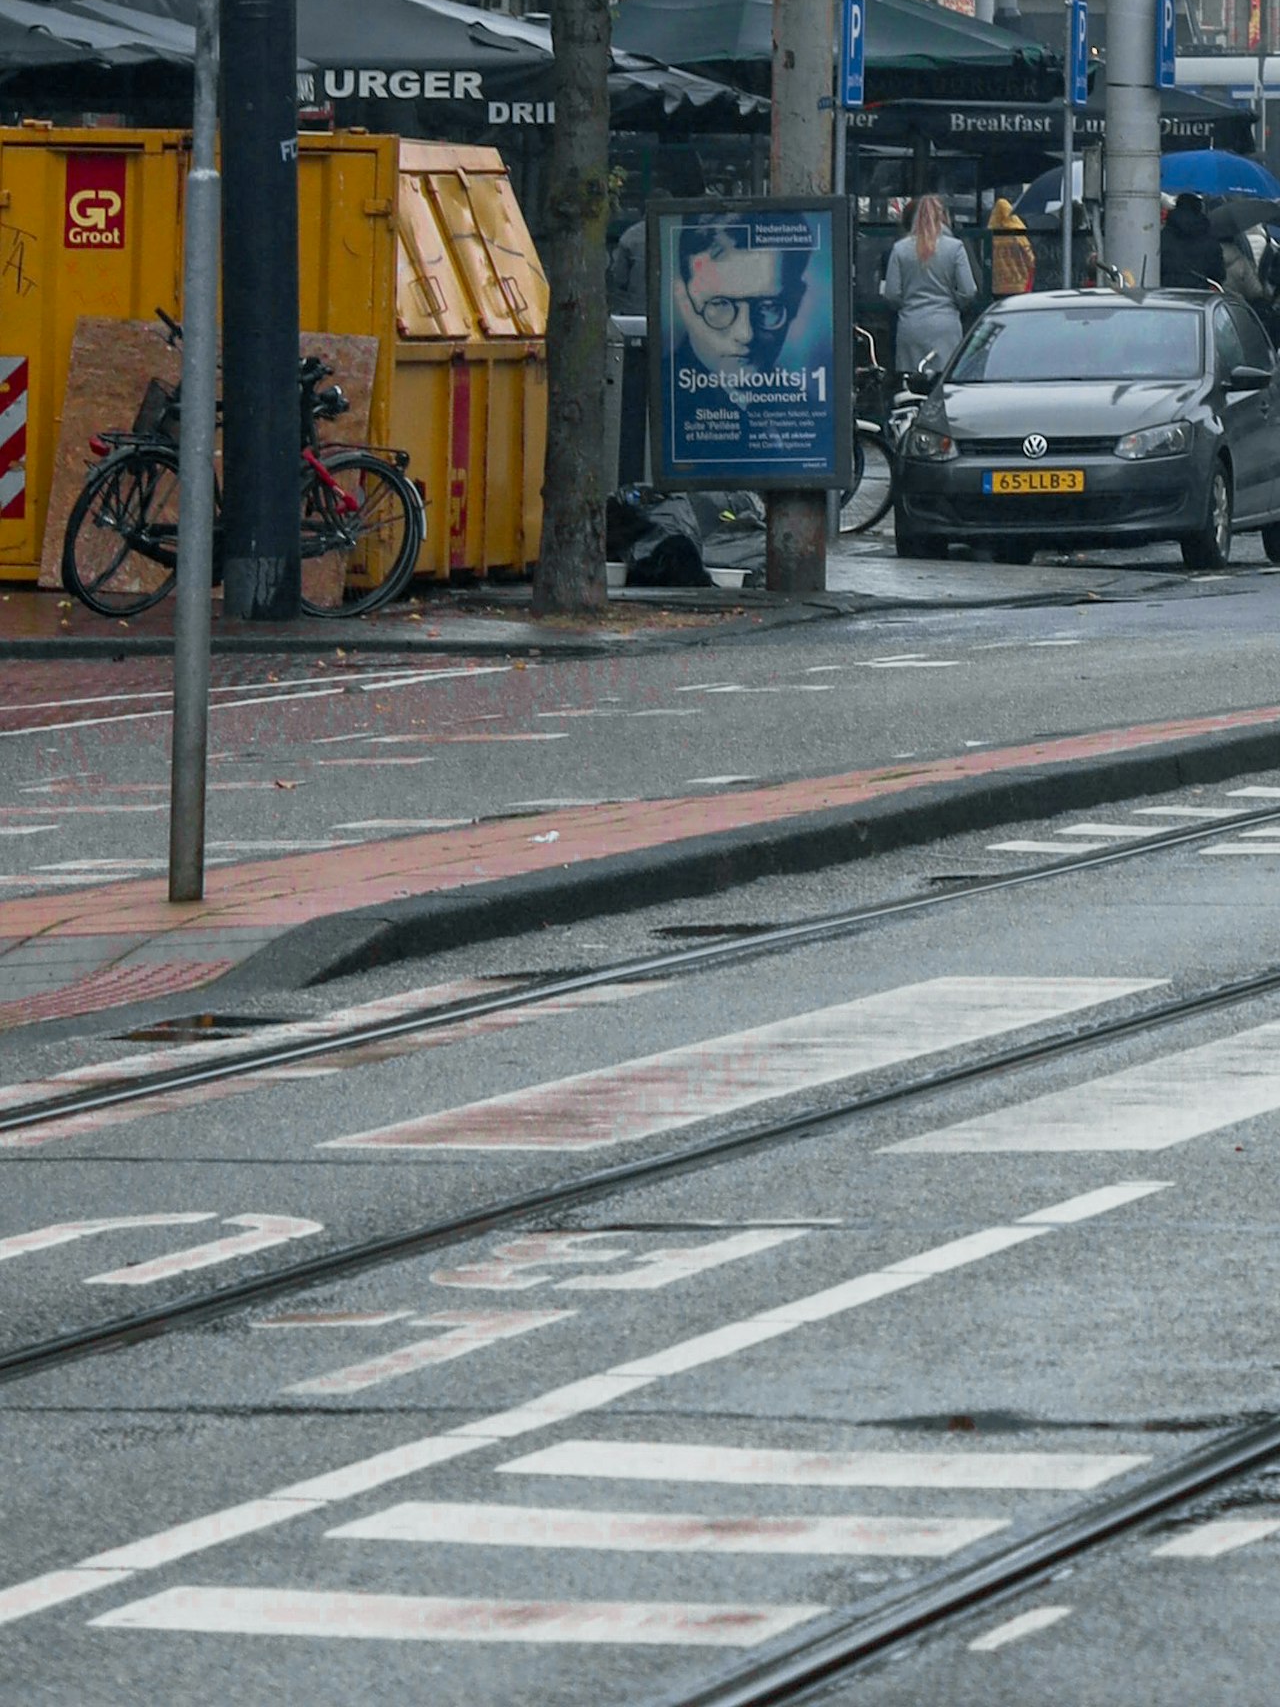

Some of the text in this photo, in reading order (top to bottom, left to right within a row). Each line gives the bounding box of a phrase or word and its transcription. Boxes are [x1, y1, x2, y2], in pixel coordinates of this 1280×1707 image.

[851, 4, 861, 59] P
[1164, 0, 1173, 47] P
[1079, 10, 1086, 60] P
[324, 69, 484, 100] URGER
[950, 112, 1052, 132] Breakfast
[68, 228, 121, 244] Groot
[755, 223, 808, 233] Nederlands
[755, 234, 813, 244] Kamerorkest
[679, 367, 807, 393] Sjostakovitsj
[811, 366, 827, 402] 1
[729, 391, 807, 403] Celloconcert
[695, 408, 740, 420] Sibelius
[1000, 473, 1077, 490] 65-LLB-3
